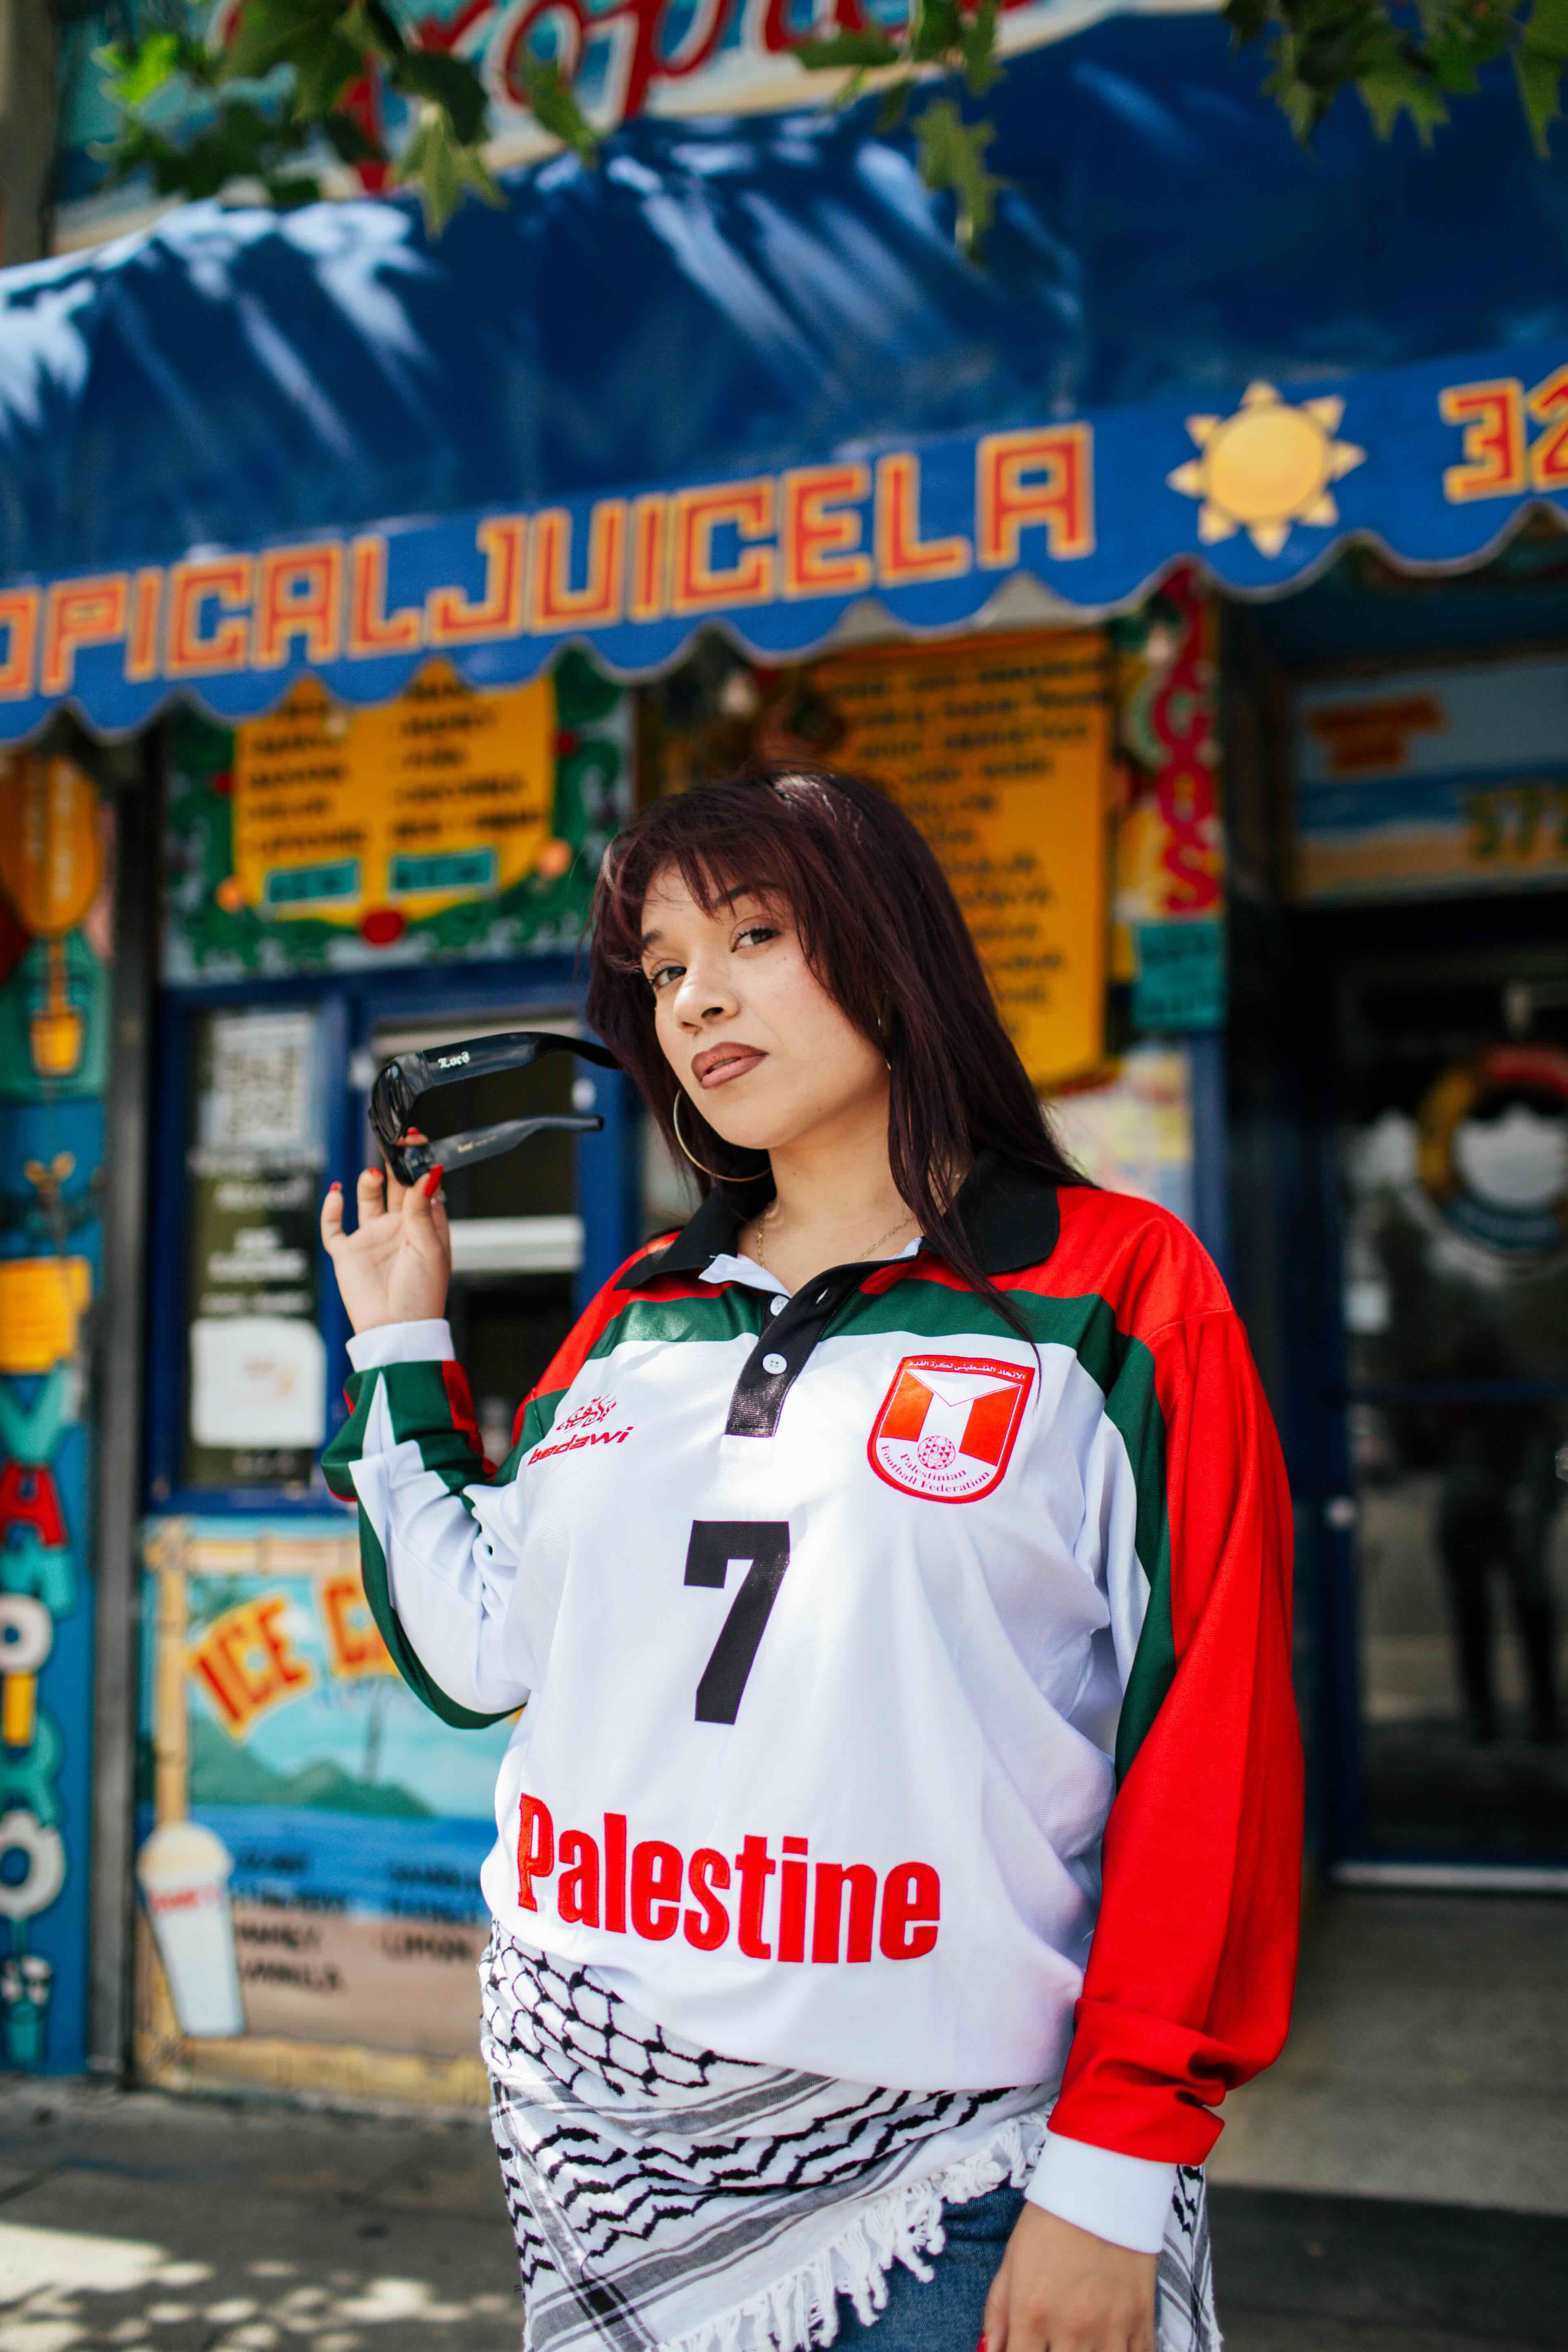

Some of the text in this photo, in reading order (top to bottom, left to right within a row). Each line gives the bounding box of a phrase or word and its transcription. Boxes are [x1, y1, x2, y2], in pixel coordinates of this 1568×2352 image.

[881, 1446, 990, 1492] Football Federation
[900, 1454, 967, 1481] Palestinian
[188, 1592, 314, 1744] ICE
[684, 1520, 790, 1725] 7
[517, 1792, 941, 1964] Palestine
